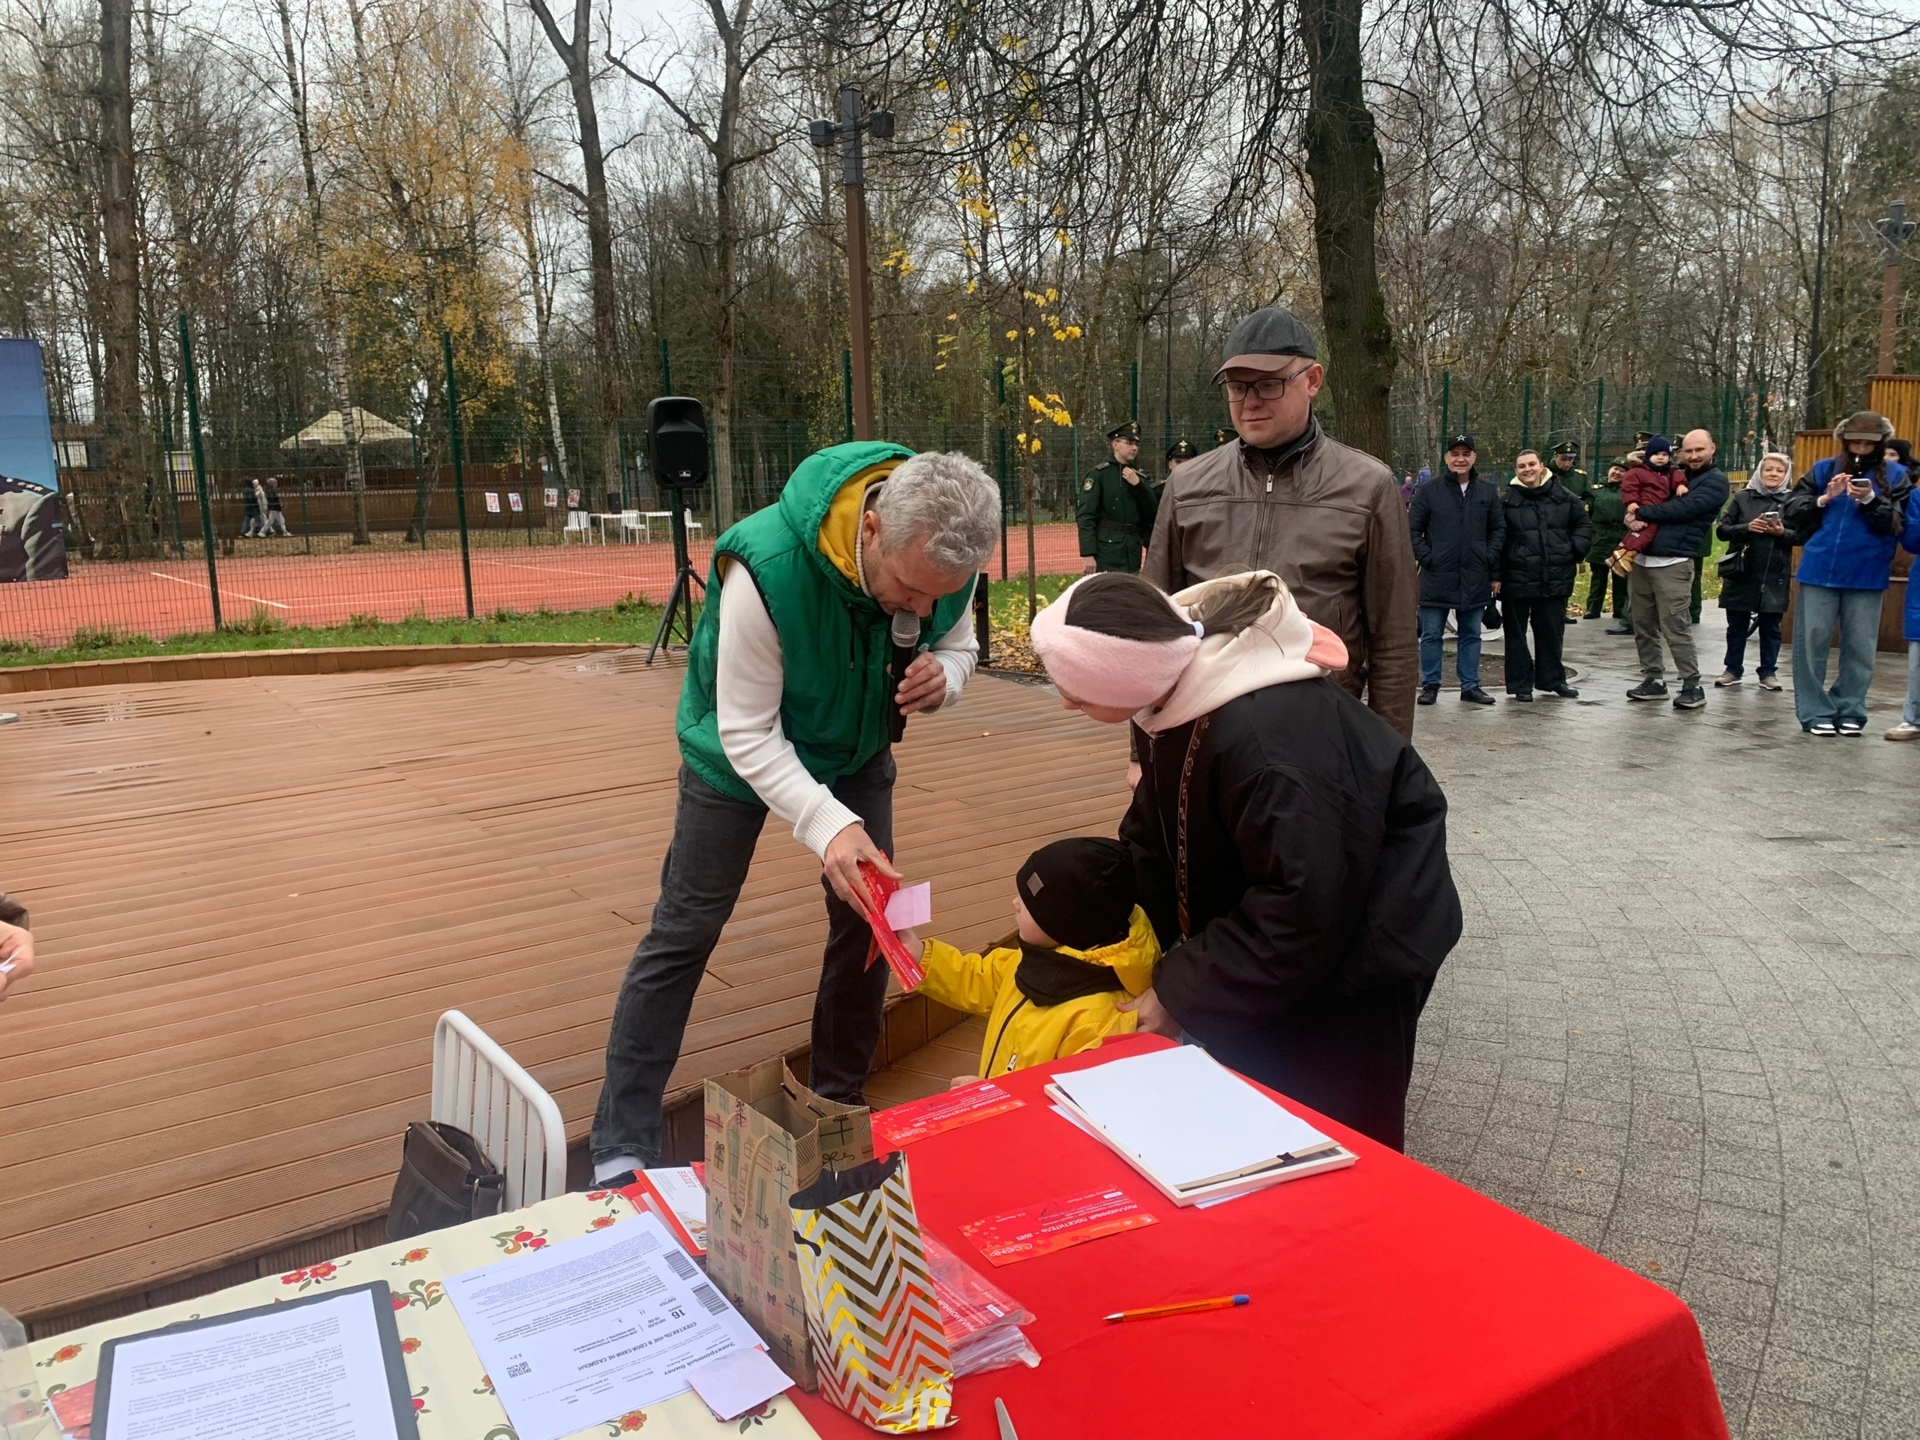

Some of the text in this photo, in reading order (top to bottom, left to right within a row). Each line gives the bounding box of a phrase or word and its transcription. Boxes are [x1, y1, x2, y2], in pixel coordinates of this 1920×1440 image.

[1087, 1203, 1139, 1221] МИЛЛИОННЫЙ
[1039, 1217, 1089, 1234] ПОСЕТИТЕЛЬ
[1013, 1232, 1035, 1241] 2025
[668, 1307, 687, 1320] 16
[936, 1298, 978, 1334] МИЛЛИОННЫЙ
[646, 1317, 667, 1329] НАЧАЛО
[661, 1320, 698, 1339] СПЕКТАКЛЬ
[605, 1353, 616, 1361] НЕ
[614, 1347, 633, 1357] САНИ
[685, 1340, 736, 1367] Электронный
[662, 1363, 687, 1376] билет
